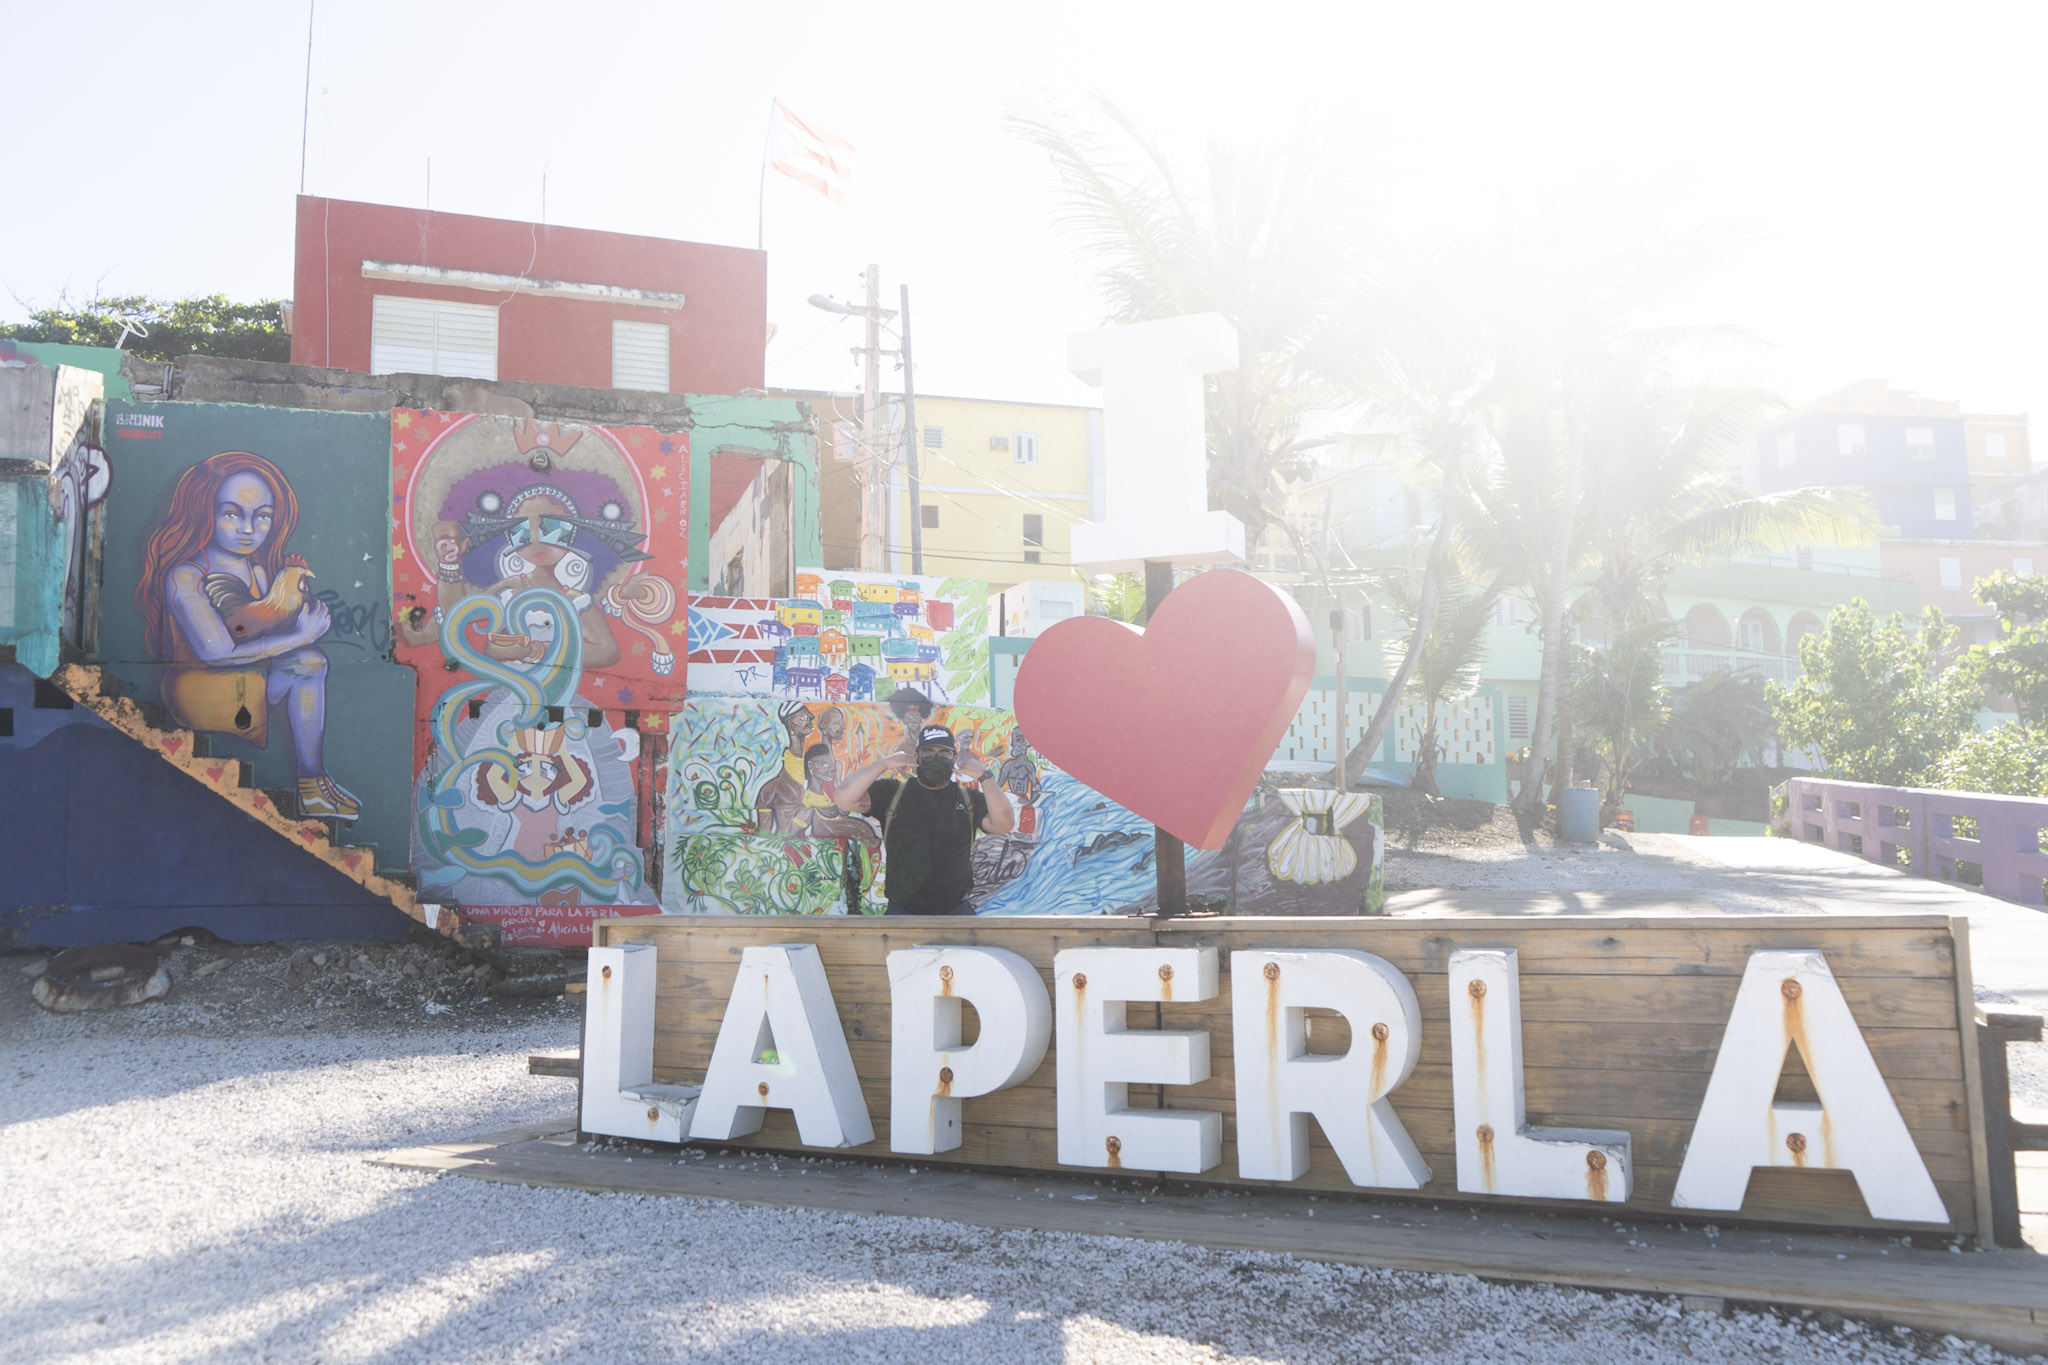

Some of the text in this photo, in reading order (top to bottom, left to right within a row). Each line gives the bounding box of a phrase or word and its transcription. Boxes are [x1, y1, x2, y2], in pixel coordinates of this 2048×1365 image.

[1067, 311, 1246, 567] I
[466, 907, 490, 915] UNA
[492, 906, 533, 917] VIRGEN
[535, 906, 563, 917] PARA
[567, 906, 582, 917] LA
